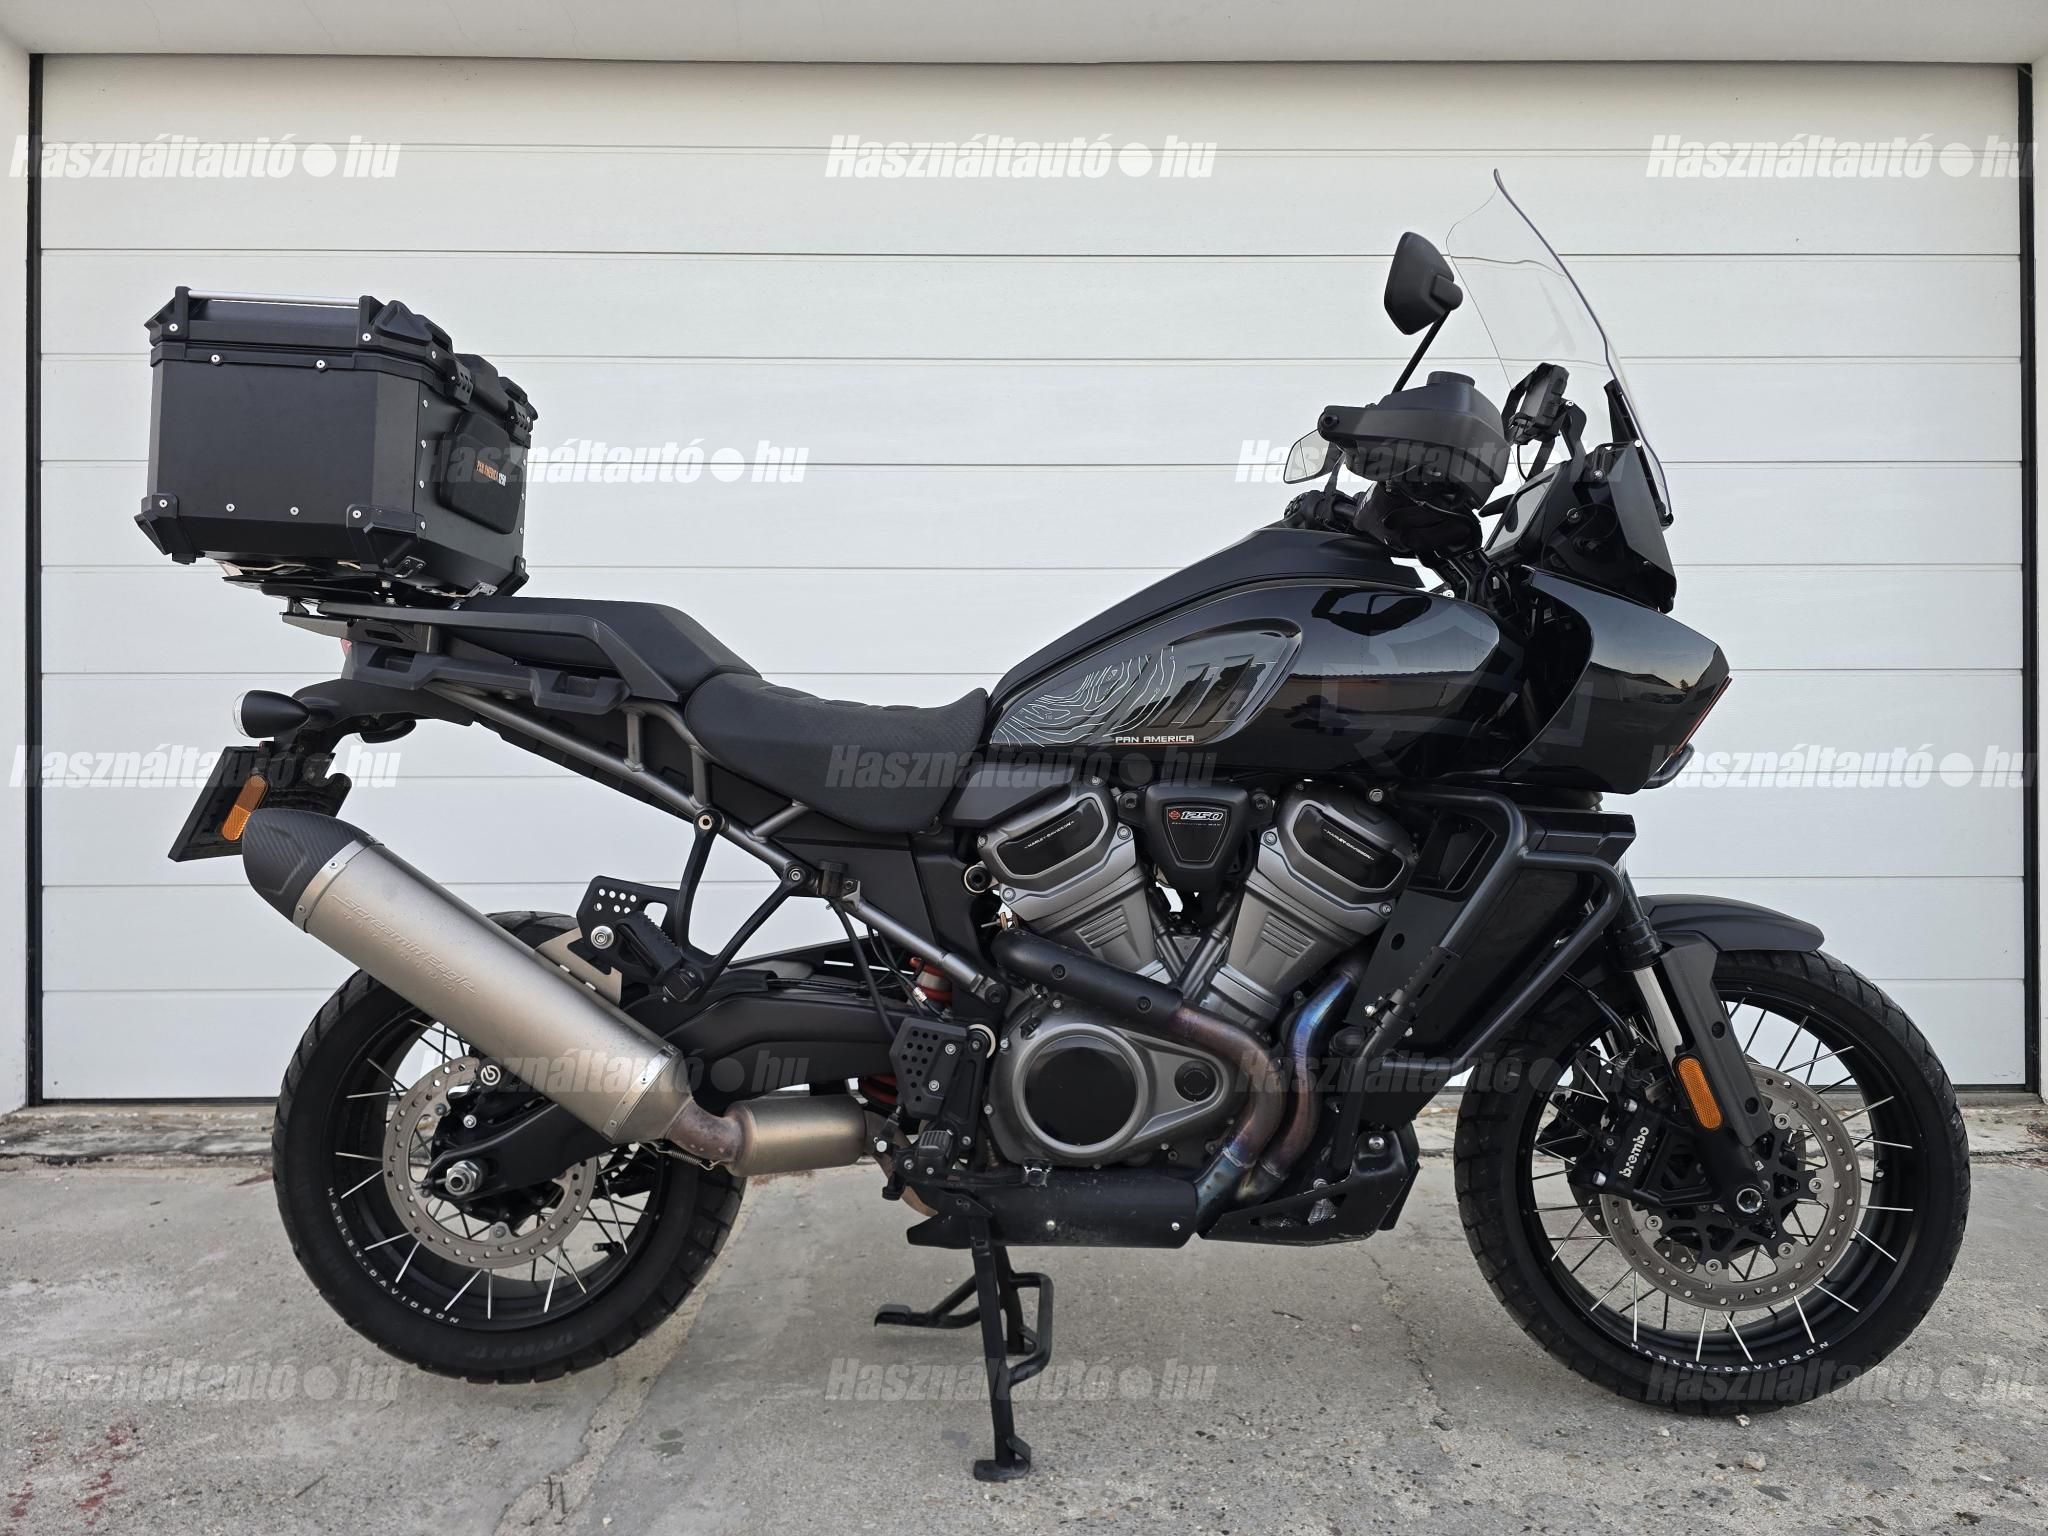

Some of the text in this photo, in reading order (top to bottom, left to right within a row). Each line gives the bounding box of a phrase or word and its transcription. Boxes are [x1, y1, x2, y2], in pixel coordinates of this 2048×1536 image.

[1143, 735, 1195, 743] AMERICA
[1181, 810, 1223, 821] 1250
[1619, 1126, 1649, 1178] brembo
[1631, 1341, 1829, 1372] HARLEY-DAVIDSON
